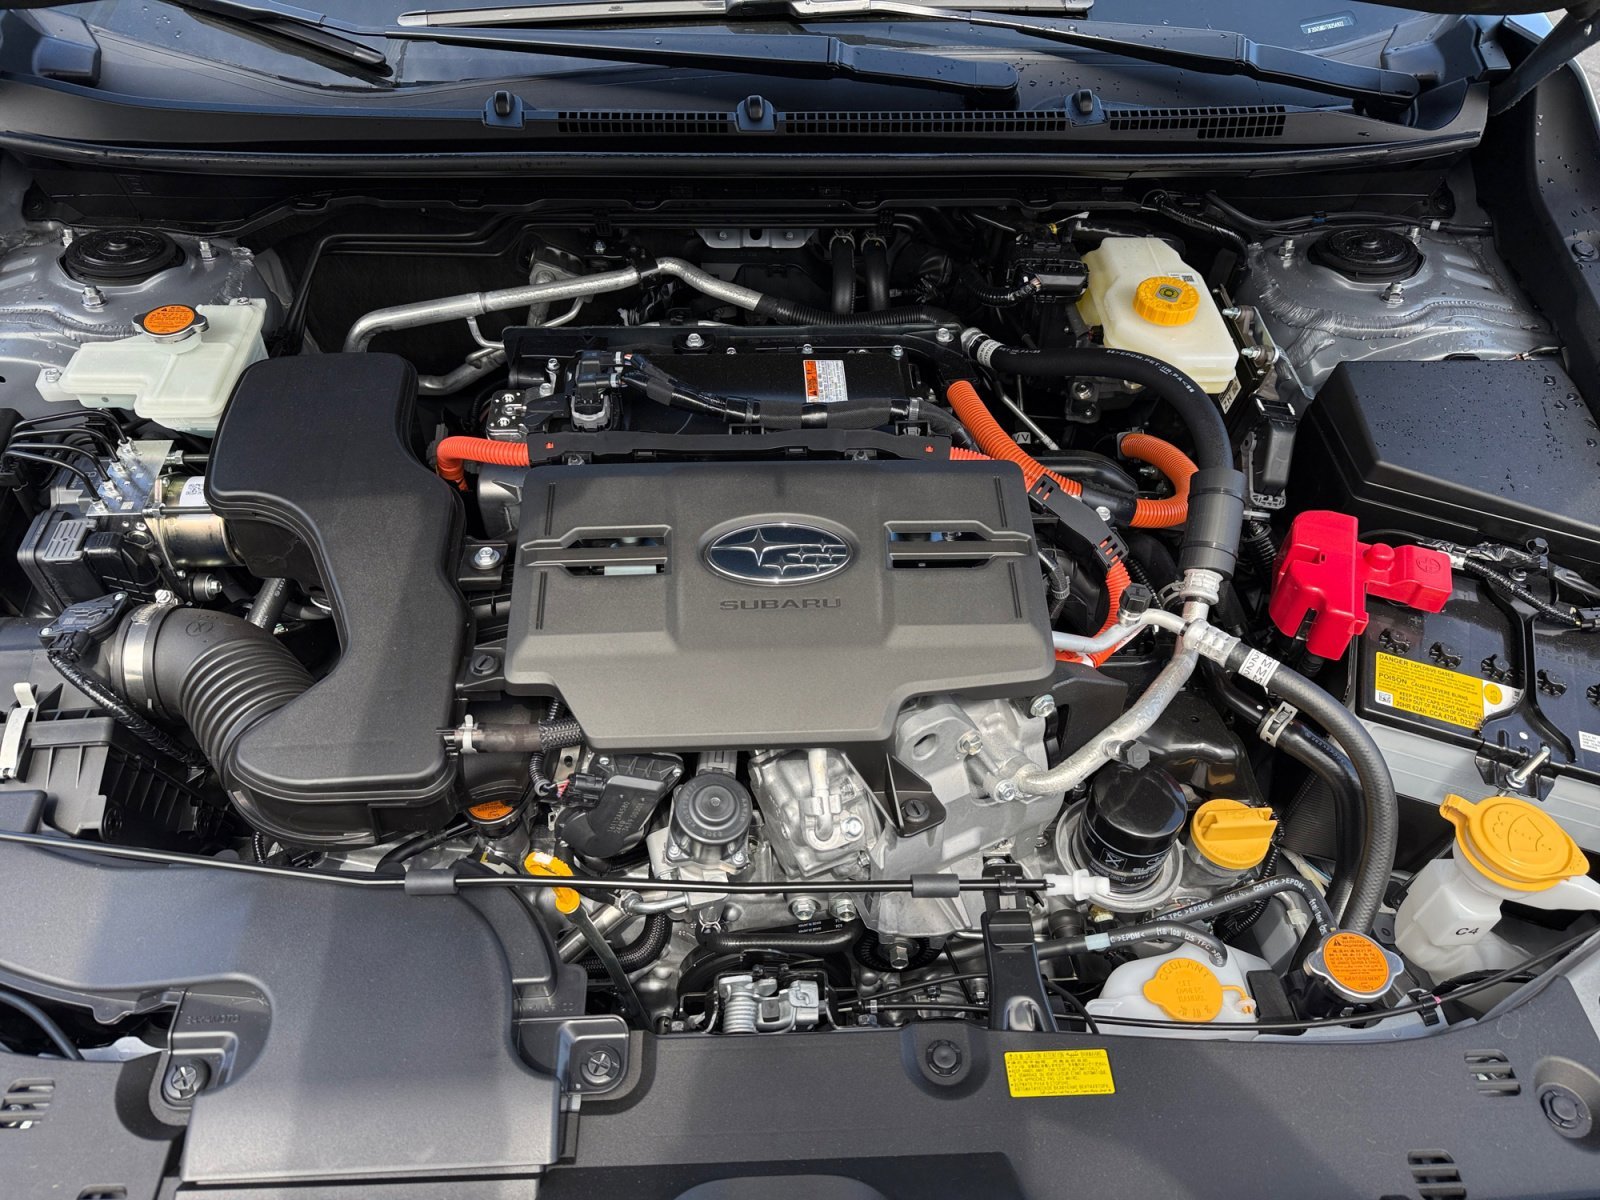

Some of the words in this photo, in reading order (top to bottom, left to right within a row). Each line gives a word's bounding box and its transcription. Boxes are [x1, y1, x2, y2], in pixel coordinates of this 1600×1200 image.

[720, 598, 841, 610] SUBARU
[1261, 658, 1273, 669] M
[1380, 654, 1408, 666] DANGER
[1411, 663, 1437, 674] EXPLOSIVE
[1255, 666, 1268, 677] M
[1379, 672, 1407, 685] POISON
[1412, 681, 1431, 691] CAUSES
[1433, 687, 1451, 696] SEVERE
[1452, 692, 1468, 701] BURNS
[1397, 700, 1411, 710] 20HR
[1413, 705, 1426, 714] 62Ah
[1430, 709, 1442, 718] CCA
[1444, 713, 1457, 722] 470A
[1399, 691, 1413, 699] KEEP
[1427, 698, 1440, 706] CAPS
[1442, 702, 1455, 710] TIGHT
[1468, 709, 1482, 718] LEVEL
[1414, 699, 1424, 707] OUT
[1433, 705, 1449, 713] REACH
[1455, 927, 1479, 935] C4
